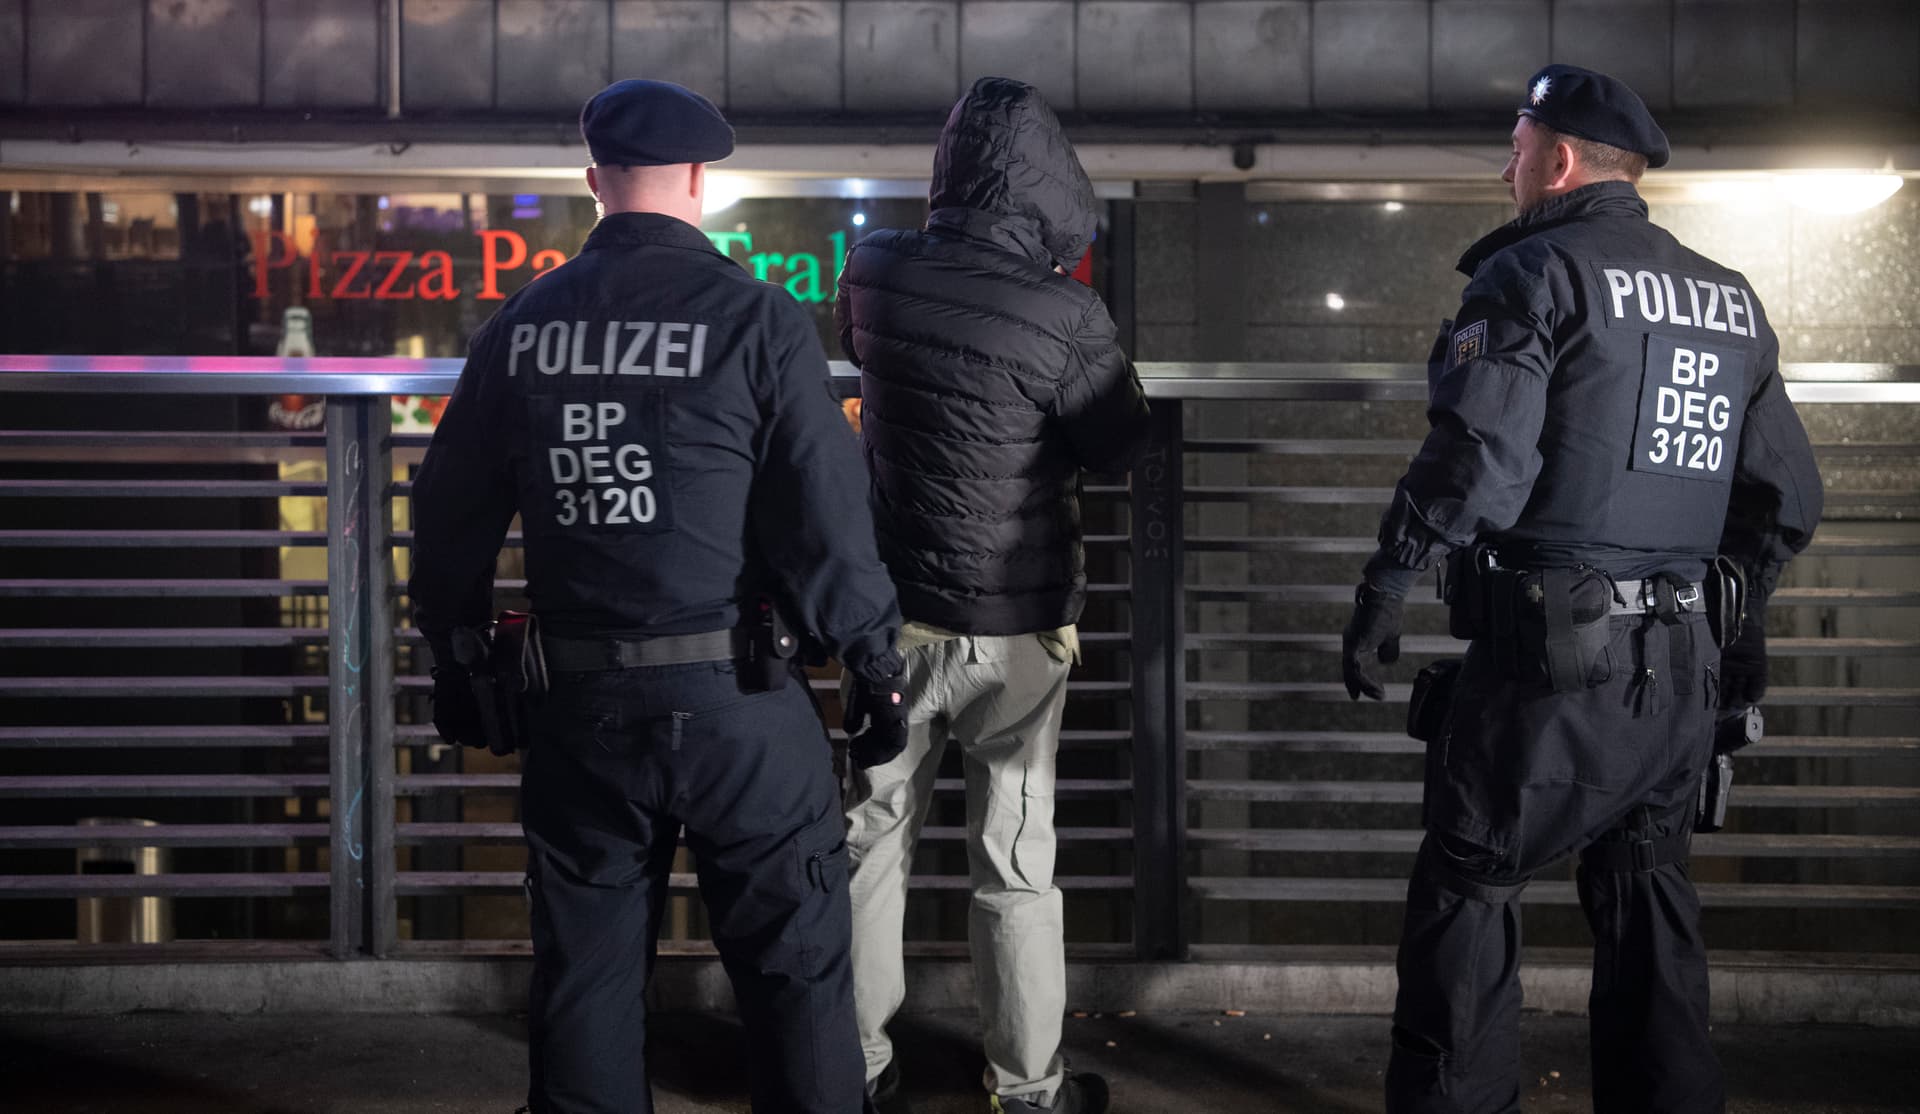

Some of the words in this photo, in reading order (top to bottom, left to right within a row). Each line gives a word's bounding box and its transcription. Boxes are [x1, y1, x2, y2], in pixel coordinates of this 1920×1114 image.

[250, 228, 460, 300] Pizza
[1603, 268, 1757, 338] POLIZEI
[508, 320, 709, 378] POLIZEI
[1456, 323, 1484, 345] POLIZEI
[1672, 347, 1719, 388] BP
[562, 402, 627, 441] BP
[1656, 386, 1730, 432] DEG
[549, 444, 653, 485] DEG
[1648, 427, 1723, 472] 3120
[554, 485, 657, 527] 3120
